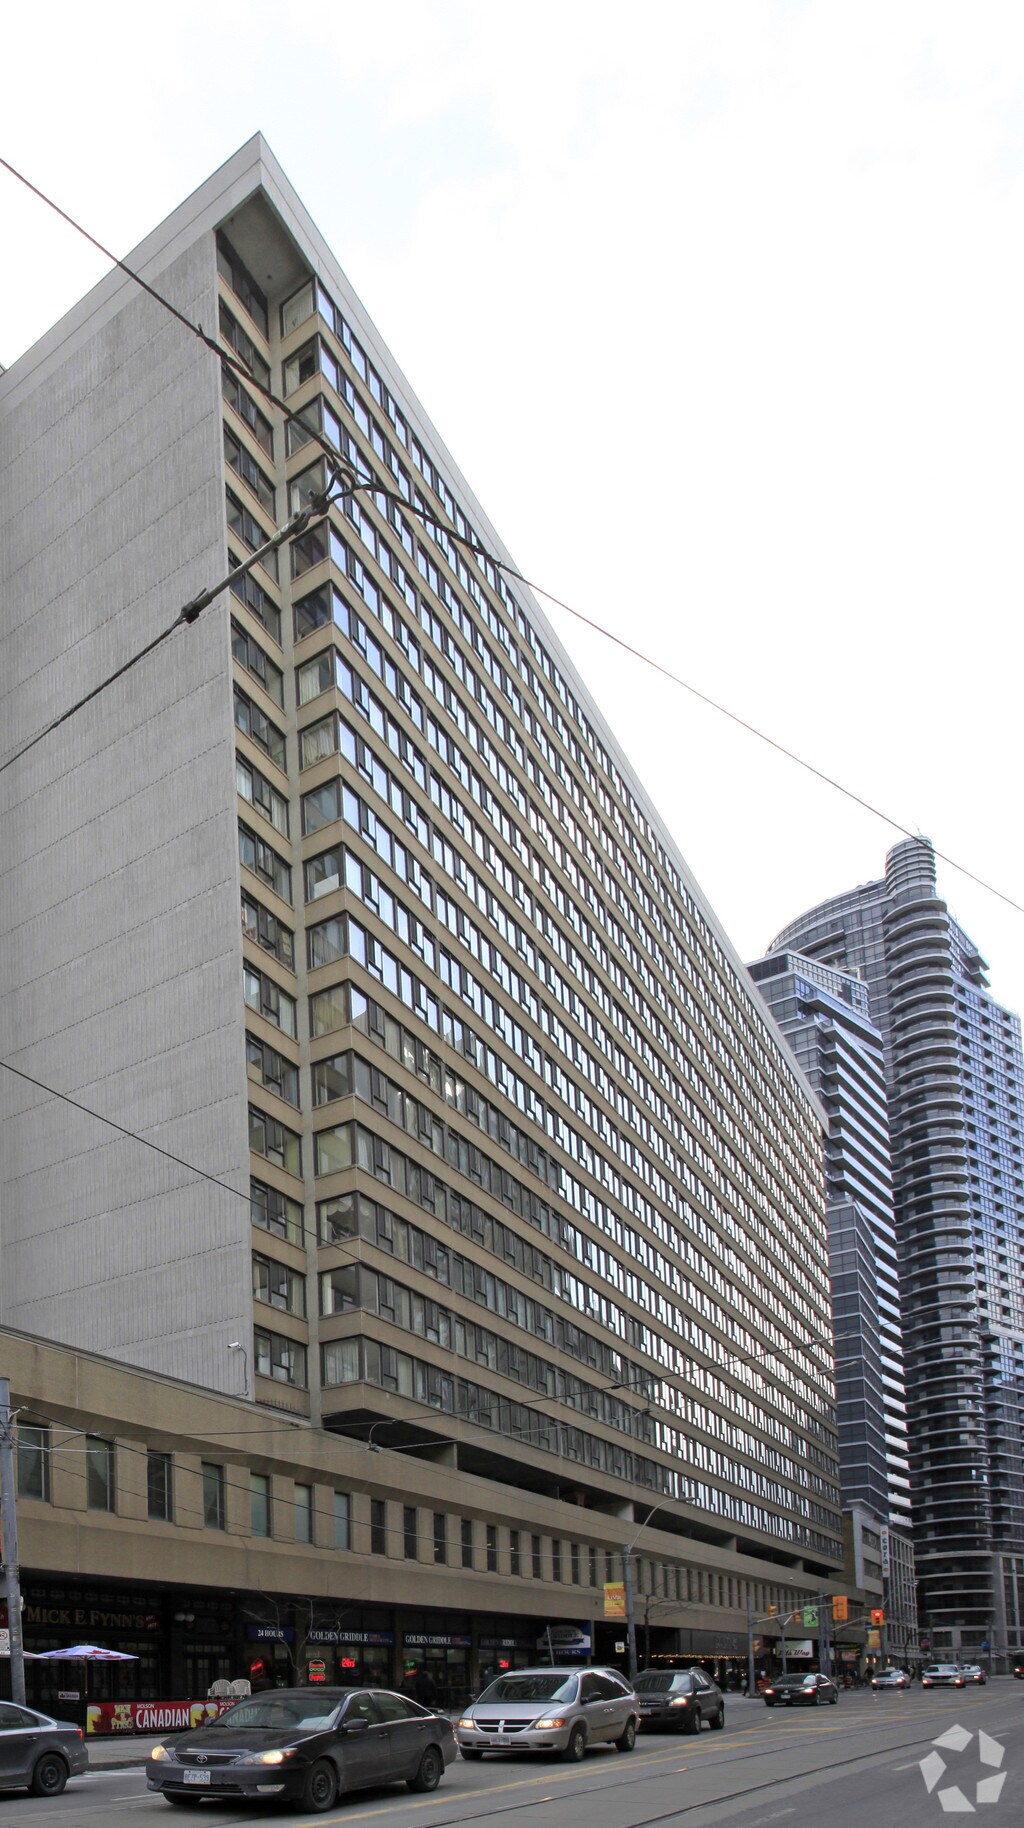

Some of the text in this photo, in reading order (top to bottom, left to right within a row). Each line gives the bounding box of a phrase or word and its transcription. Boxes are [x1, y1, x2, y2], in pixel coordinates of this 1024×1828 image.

[26, 1605, 71, 1624] MICK
[89, 1610, 145, 1629] FYNN'S
[257, 1629, 284, 1638] 24 HOURS
[310, 1631, 339, 1641] GOLDEN
[339, 1632, 369, 1642] GRIDDLE
[405, 1634, 428, 1645] GOLDEN
[428, 1635, 452, 1645] GRIDDLE
[136, 1708, 190, 1728] CANADIAN
